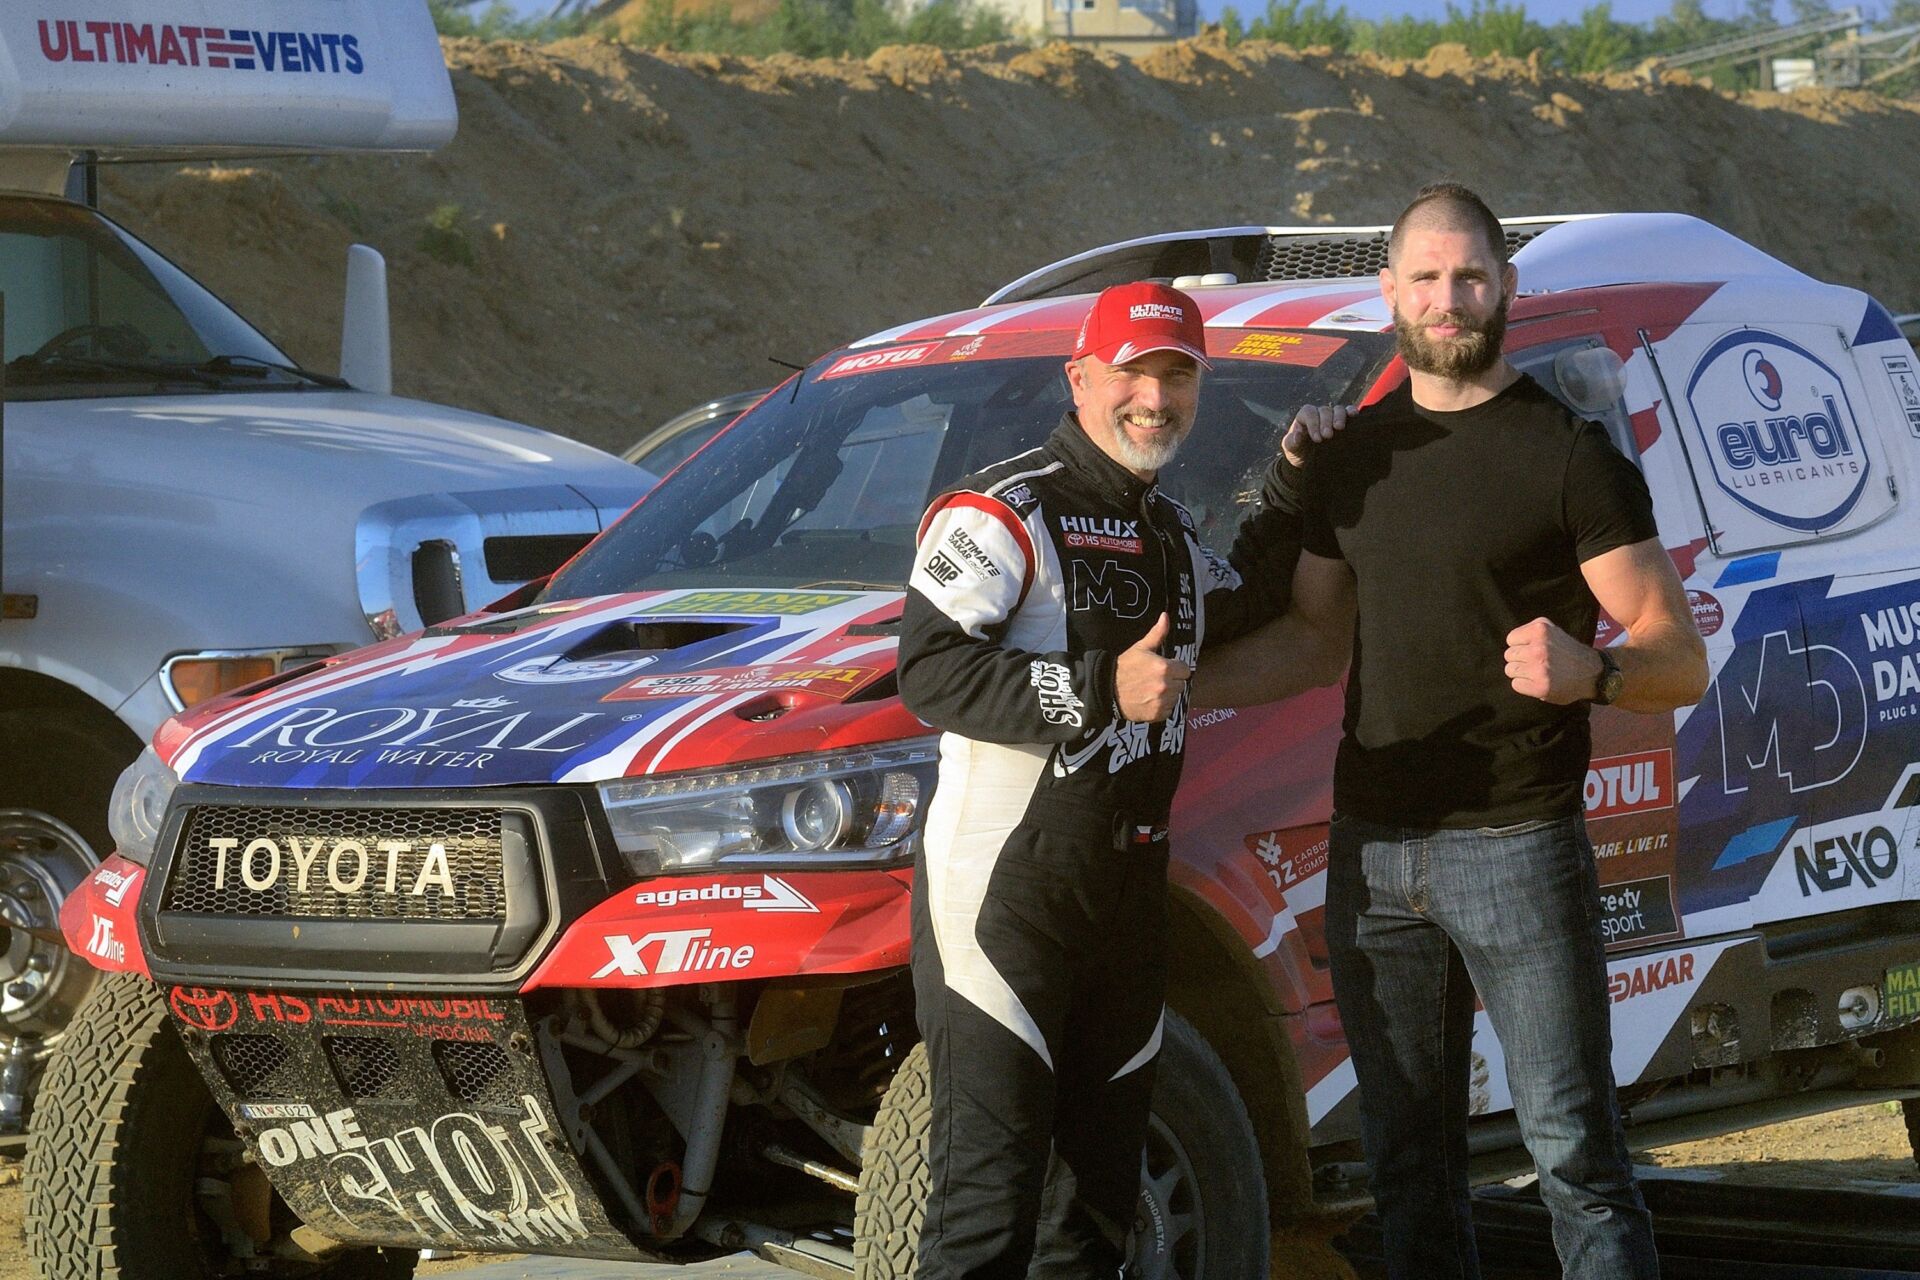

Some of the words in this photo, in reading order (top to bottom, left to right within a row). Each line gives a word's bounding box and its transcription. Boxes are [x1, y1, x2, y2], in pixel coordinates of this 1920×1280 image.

[1130, 303, 1183, 316] ULTIMATE
[1130, 312, 1161, 320] DAKAR
[1229, 347, 1267, 356] LIVE
[1262, 350, 1284, 358] IT.
[1236, 340, 1283, 350] DARE.
[830, 347, 929, 374] MOTUL
[1717, 394, 1854, 471] eurol
[1732, 460, 1860, 489] LUBRICANTS
[1060, 516, 1139, 538] HILUX
[947, 534, 972, 560] DAKAR
[953, 527, 1001, 578] ULTIMATE
[1085, 535, 1100, 546] HS
[1100, 537, 1140, 549] AUTOMOBIL
[927, 555, 959, 582] OMP
[692, 593, 845, 605] MANN
[1072, 559, 1151, 619] MD
[650, 602, 818, 614] FILTER
[649, 675, 704, 688] 338
[773, 668, 863, 682] 2021
[1030, 660, 1042, 687] ONE
[648, 685, 721, 696] SAUDI
[722, 679, 814, 691] ARABIA
[1039, 661, 1083, 728] SHOT
[1189, 708, 1237, 730] VYSOČINA
[1714, 630, 1868, 795] MD
[1880, 706, 1907, 722] PLUG
[1910, 703, 1917, 716] &
[227, 707, 605, 753] ROYAL
[250, 749, 366, 765] ROYAL
[373, 750, 495, 770] WATER
[1583, 761, 1661, 812] OTUL
[1625, 834, 1652, 855] LIVE
[1653, 833, 1669, 850] IT.
[209, 837, 455, 898] TOYOTA
[1794, 826, 1898, 897] NEXO
[635, 883, 762, 907] agados
[86, 913, 125, 965] XTline
[1601, 910, 1646, 943] sport
[590, 928, 755, 979] XTline
[1887, 968, 1920, 995] MA
[248, 992, 313, 1024] HS
[318, 993, 504, 1020] AUTOMOBIL
[410, 1023, 494, 1042] VYSOČINA
[247, 1105, 268, 1117] TN
[258, 1107, 369, 1167] ONE
[1140, 1189, 1166, 1255] FONDMETAL
